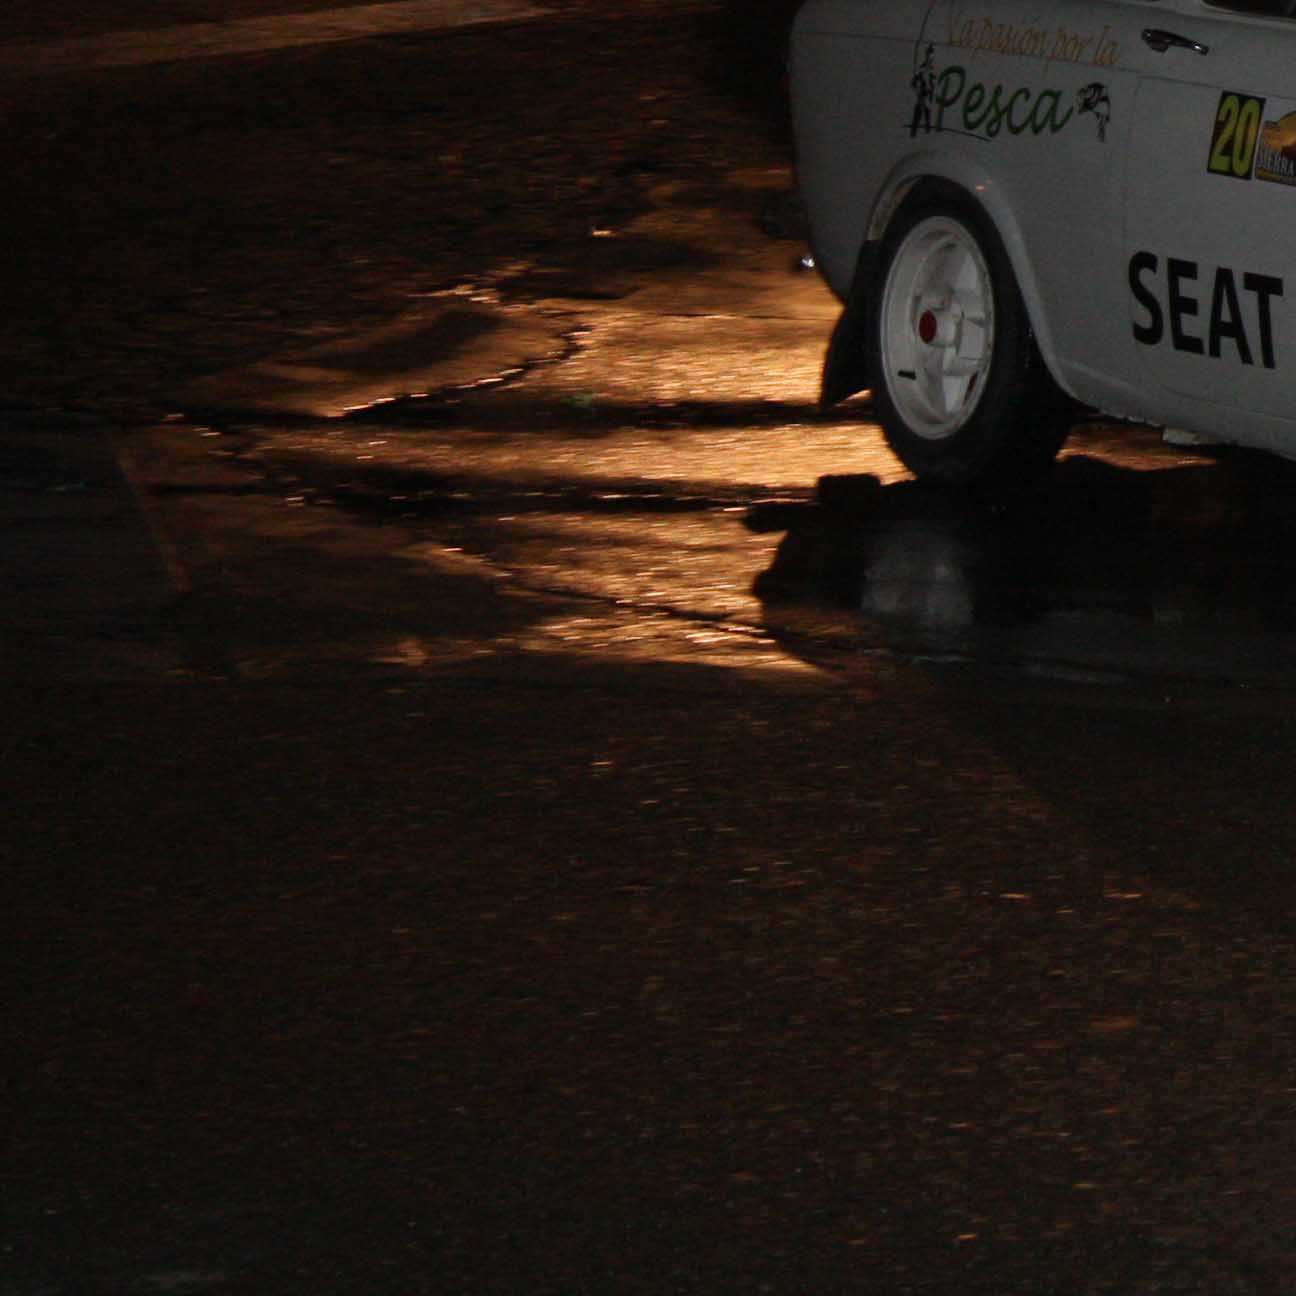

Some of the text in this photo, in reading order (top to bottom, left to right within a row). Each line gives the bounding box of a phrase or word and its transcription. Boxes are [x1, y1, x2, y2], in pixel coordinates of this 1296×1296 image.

[936, 65, 1073, 137] Pesca
[1209, 94, 1261, 176] 20
[1129, 251, 1283, 369] SEAT
